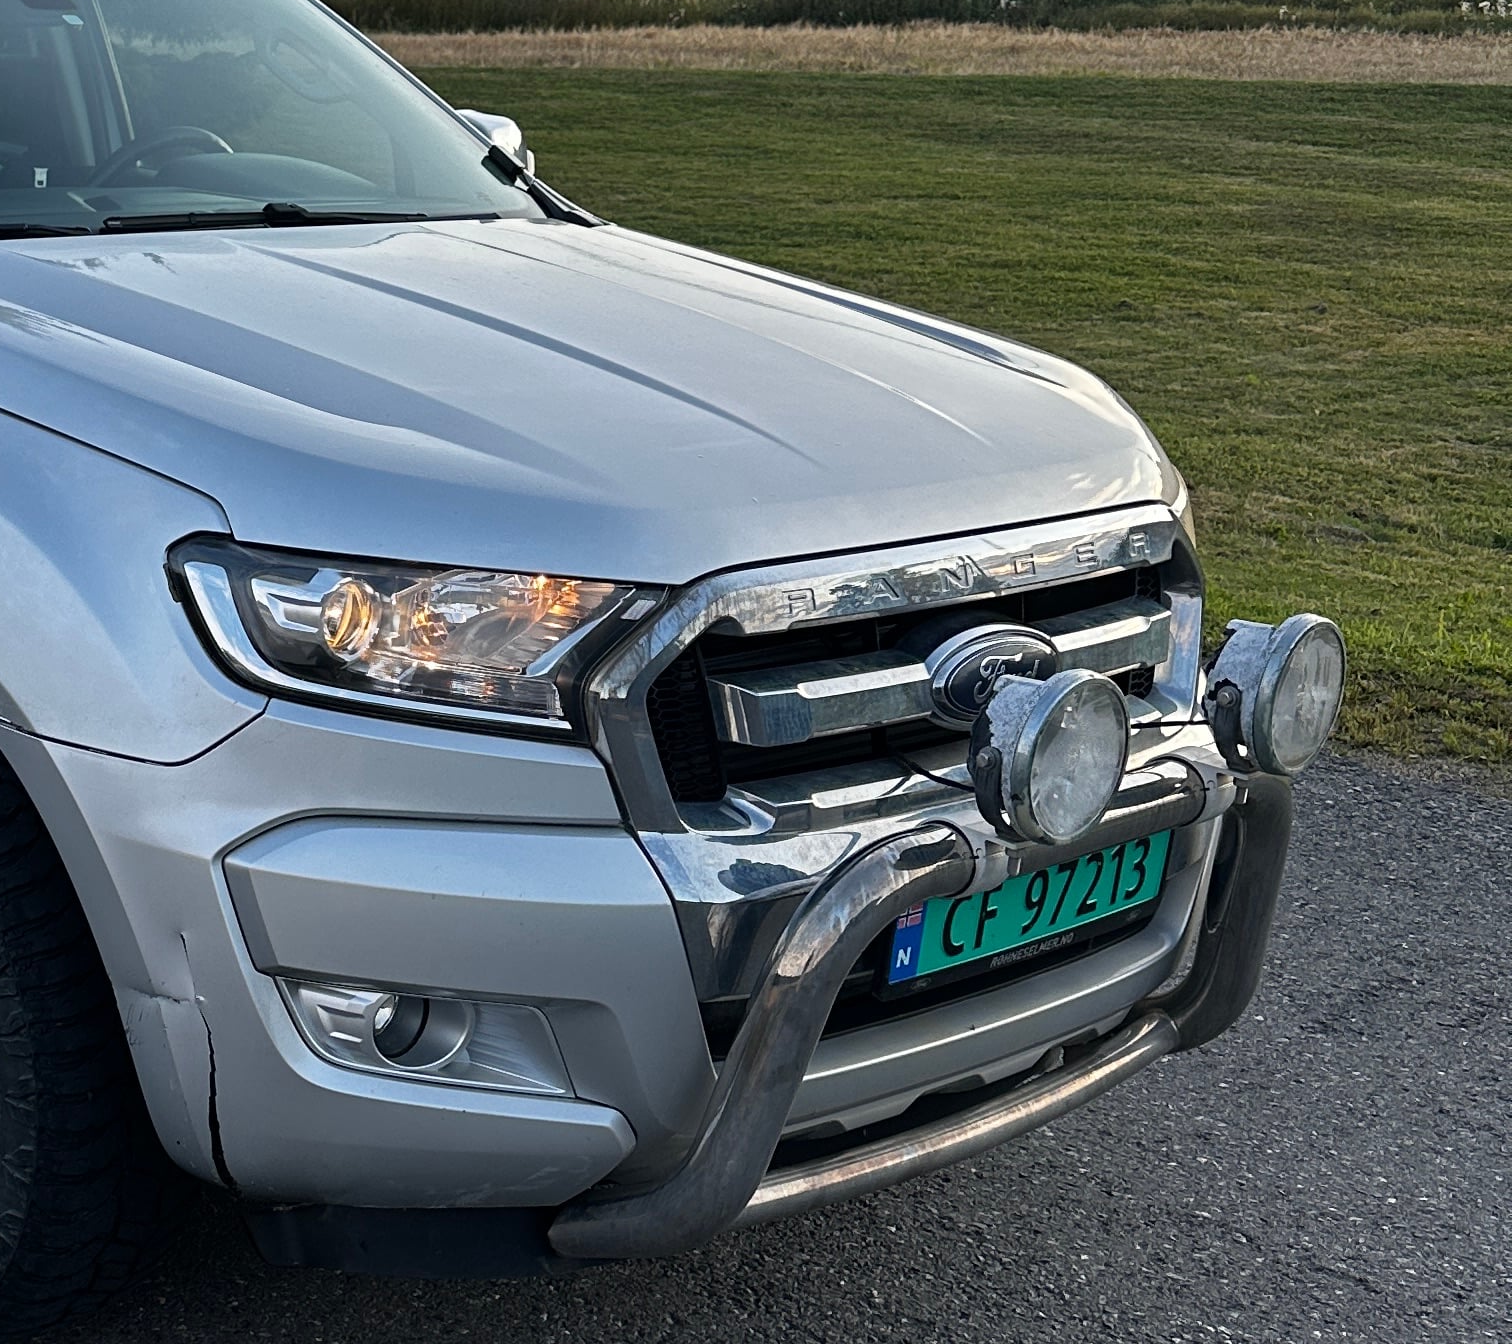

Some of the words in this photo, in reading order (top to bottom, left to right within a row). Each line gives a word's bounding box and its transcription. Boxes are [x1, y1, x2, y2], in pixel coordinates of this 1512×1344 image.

[781, 532, 1151, 615] RANGER
[942, 883, 1004, 957] CF
[1020, 837, 1152, 936] 97213
[895, 946, 912, 968] N
